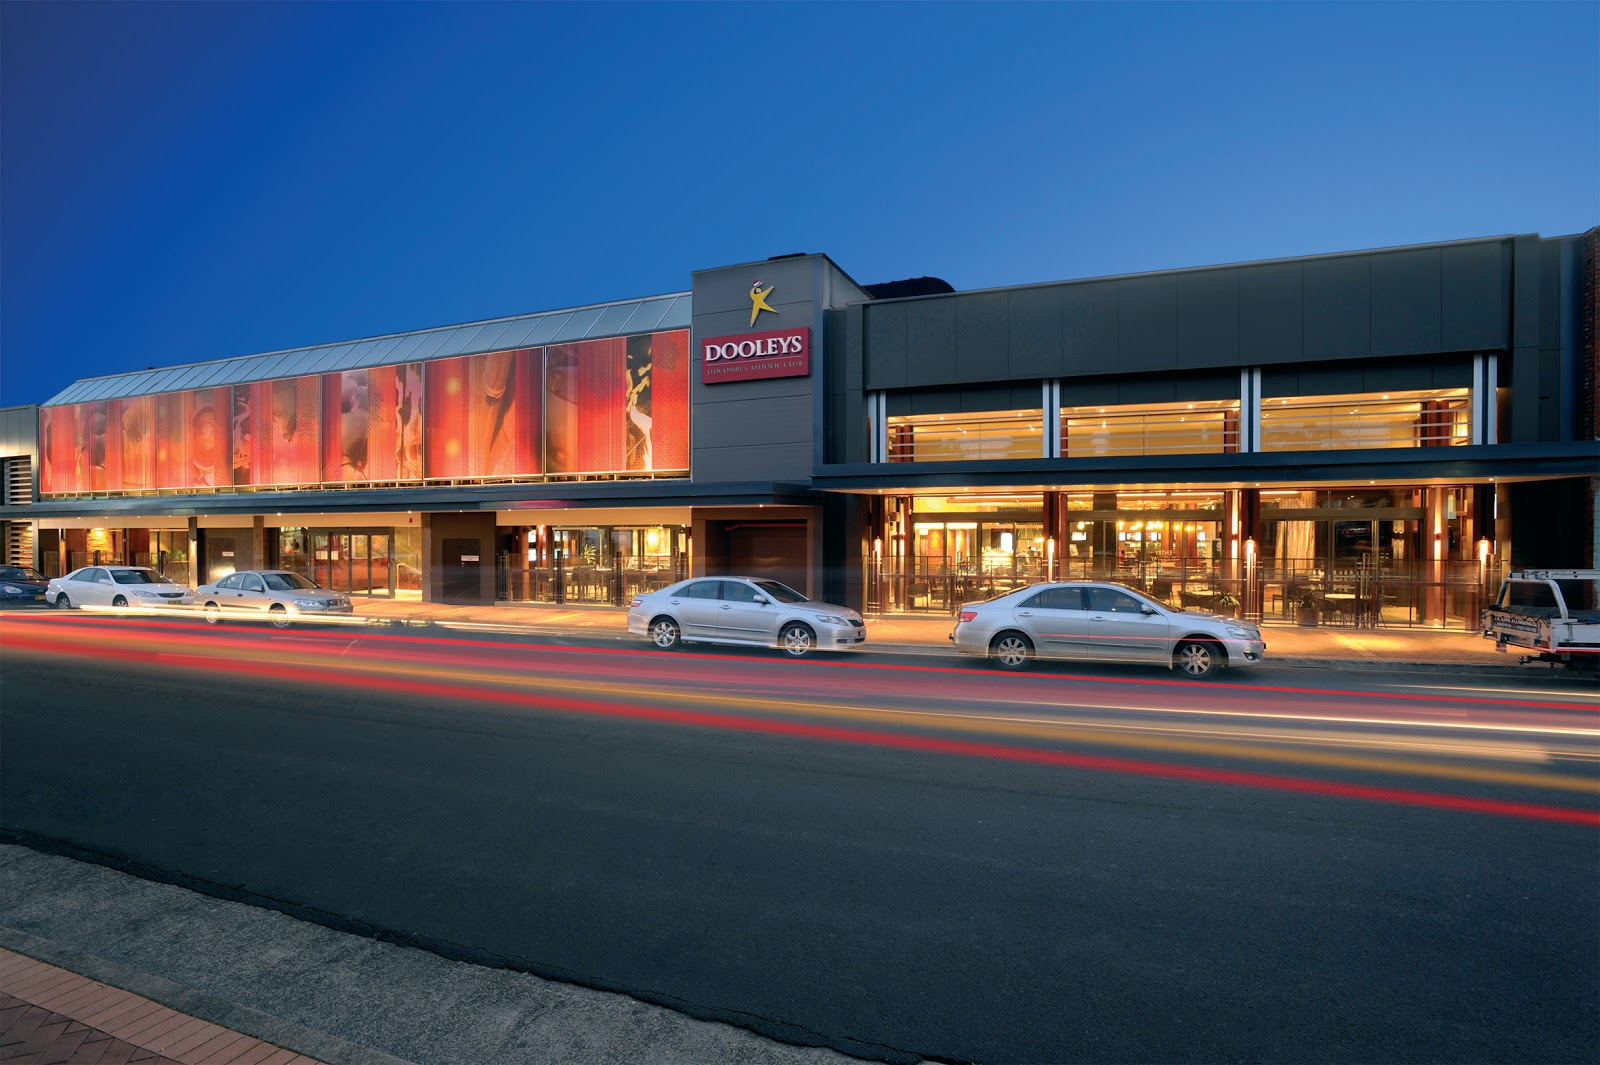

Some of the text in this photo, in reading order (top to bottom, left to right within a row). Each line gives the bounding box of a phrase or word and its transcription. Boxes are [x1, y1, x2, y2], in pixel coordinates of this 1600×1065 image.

[705, 335, 802, 361] DOOLEYS
[744, 362, 780, 371] CATHOLIC
[783, 360, 803, 368] CLUB
